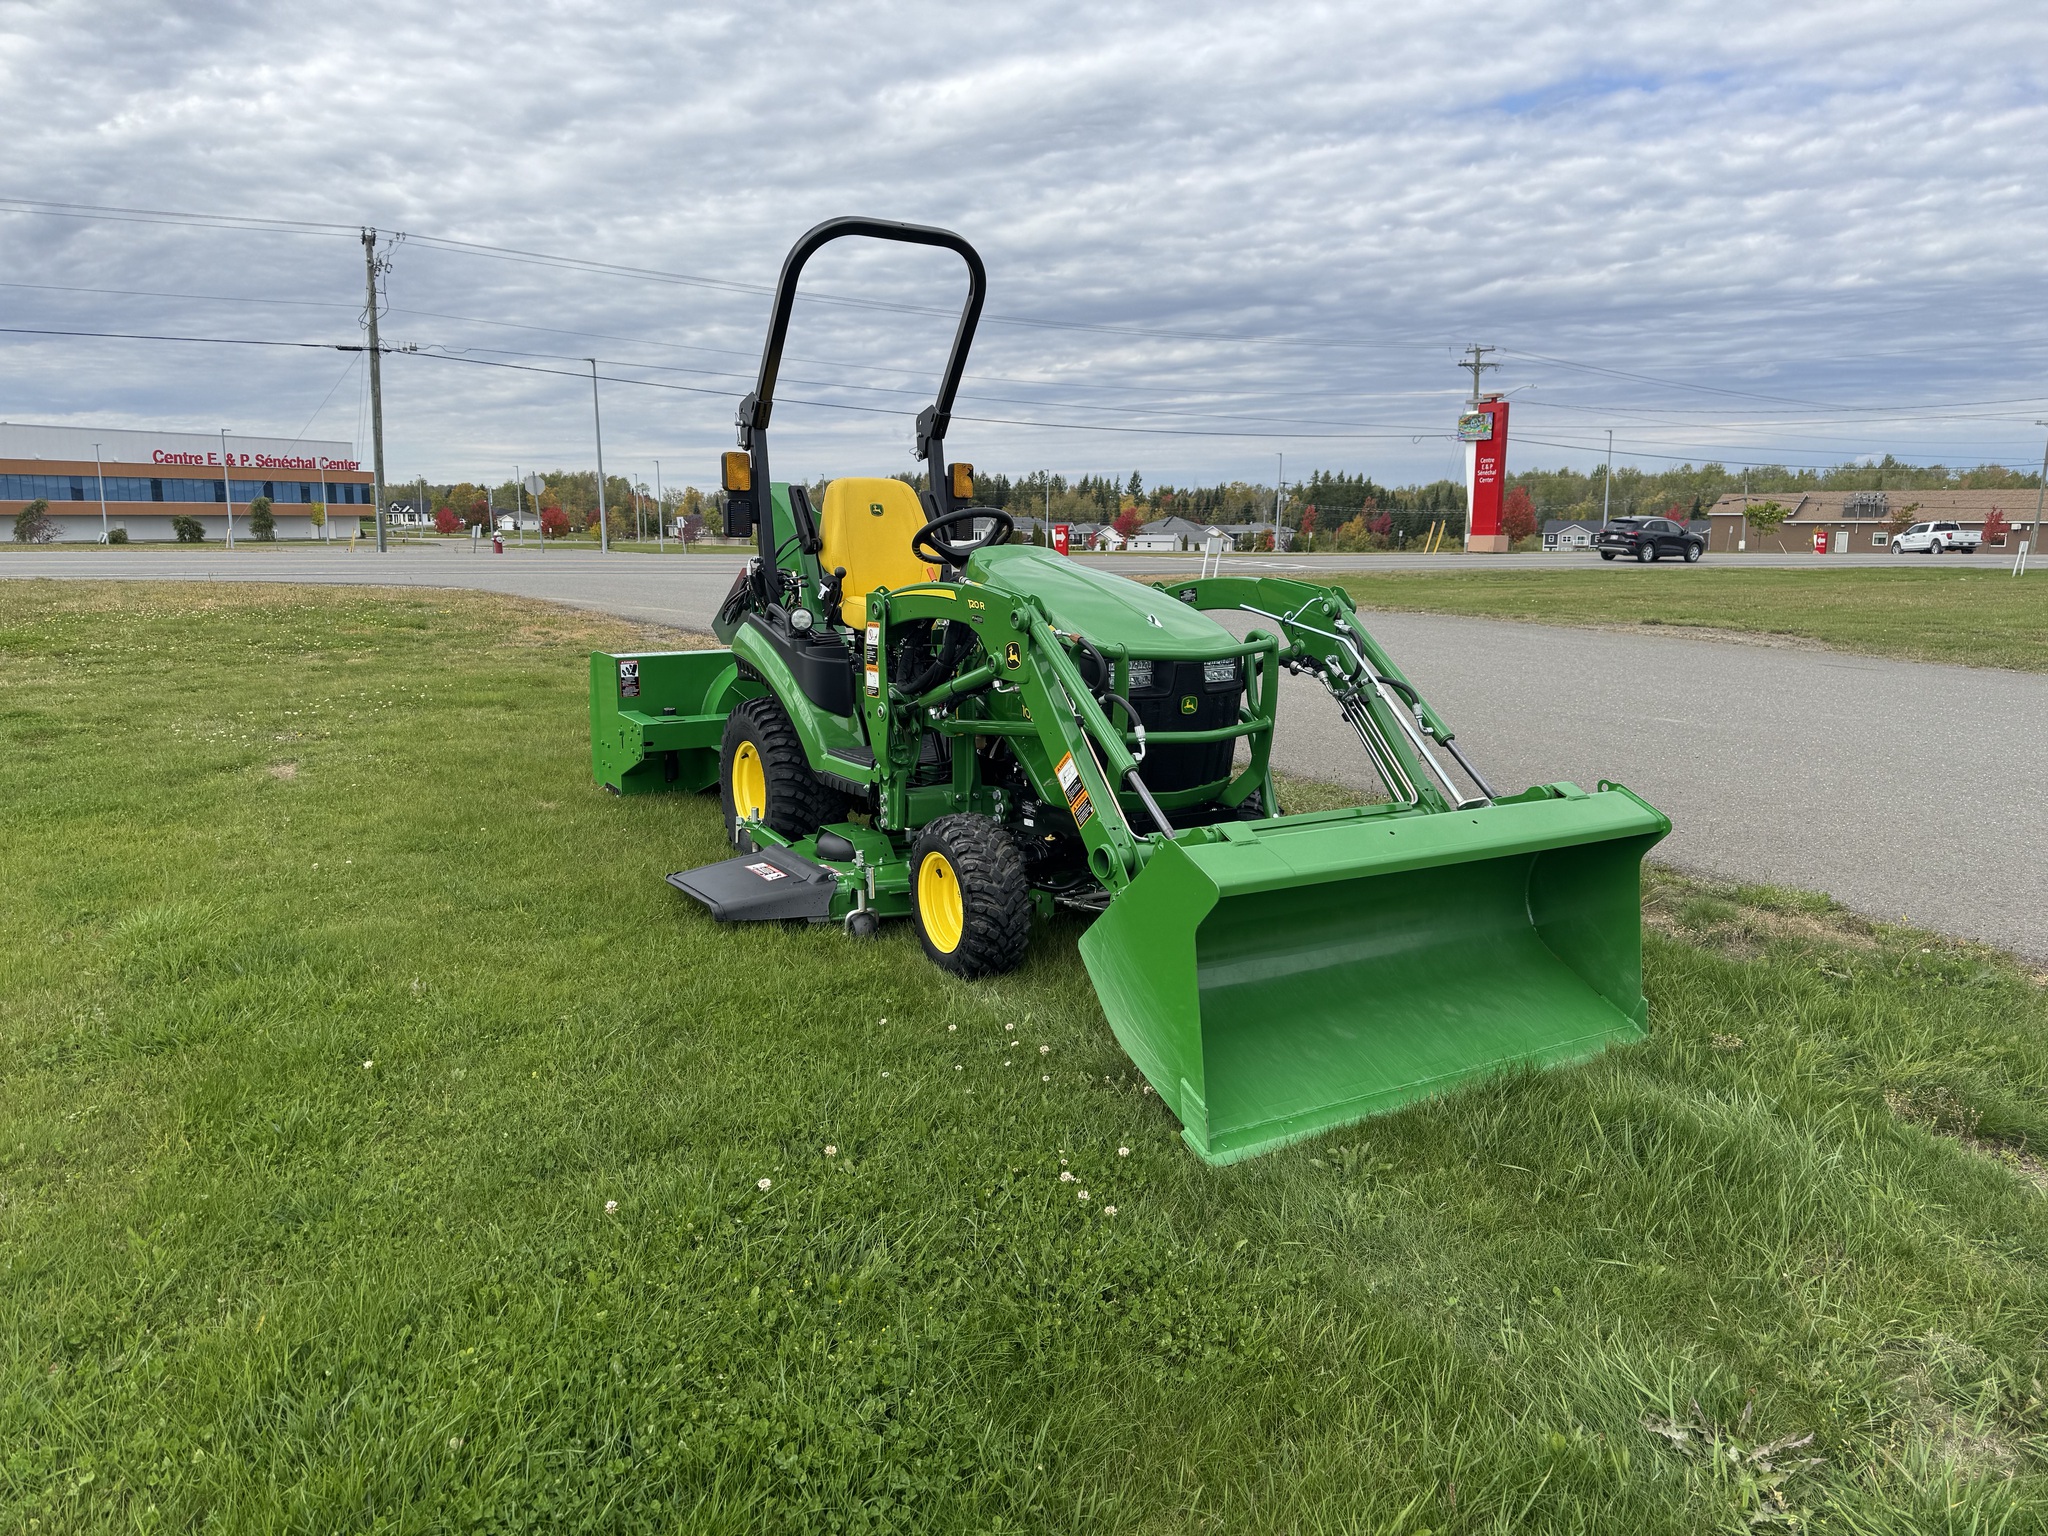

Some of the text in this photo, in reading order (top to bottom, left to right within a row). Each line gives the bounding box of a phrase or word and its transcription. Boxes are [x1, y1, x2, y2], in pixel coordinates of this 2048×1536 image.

[152, 449, 360, 470] Centre E. & P. Sénéchal Center
